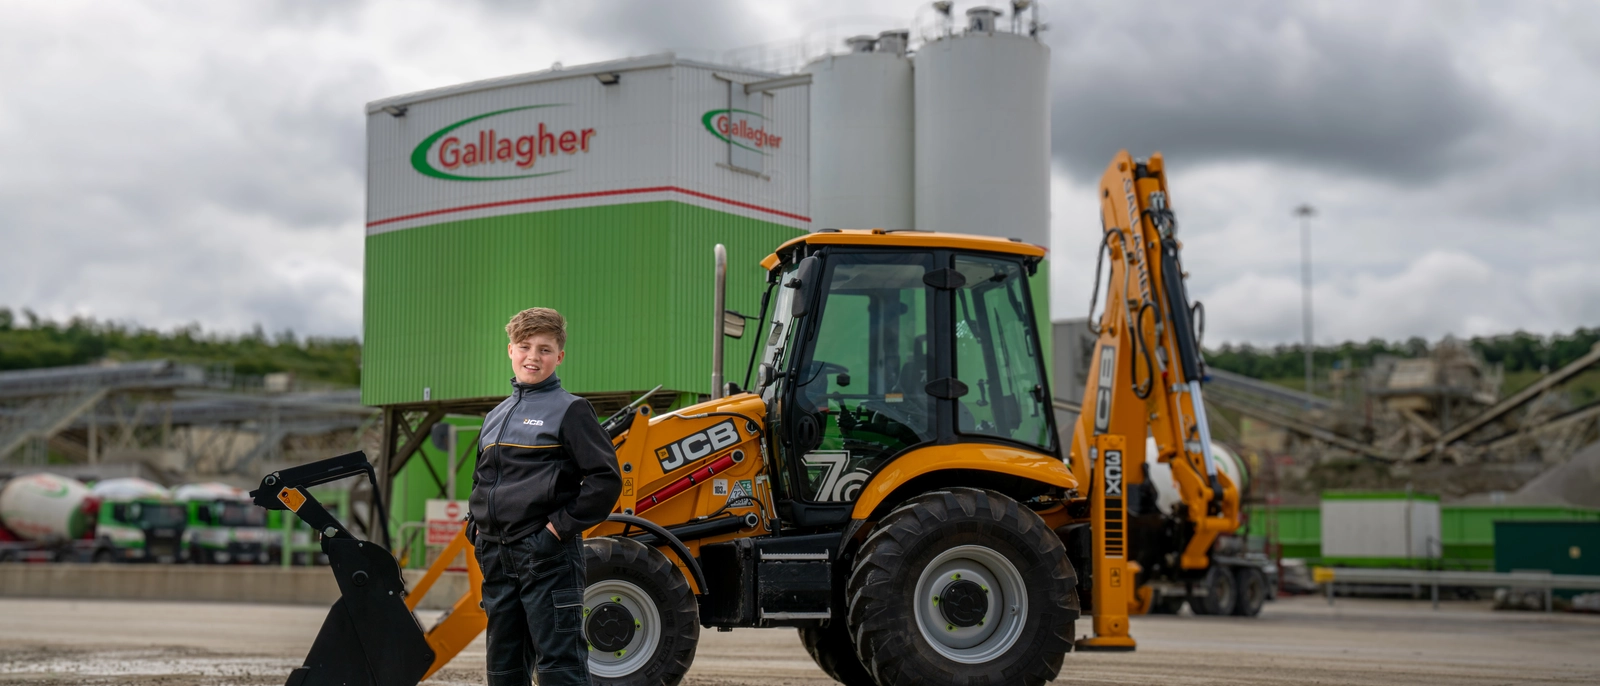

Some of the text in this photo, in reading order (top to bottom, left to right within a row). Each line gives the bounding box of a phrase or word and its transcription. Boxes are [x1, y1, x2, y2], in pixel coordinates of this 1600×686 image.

[439, 122, 595, 169] Gallagher
[717, 115, 782, 148] Gallagher
[523, 418, 544, 426] JCB
[661, 421, 739, 470] JCB
[1105, 451, 1122, 494] 3CX
